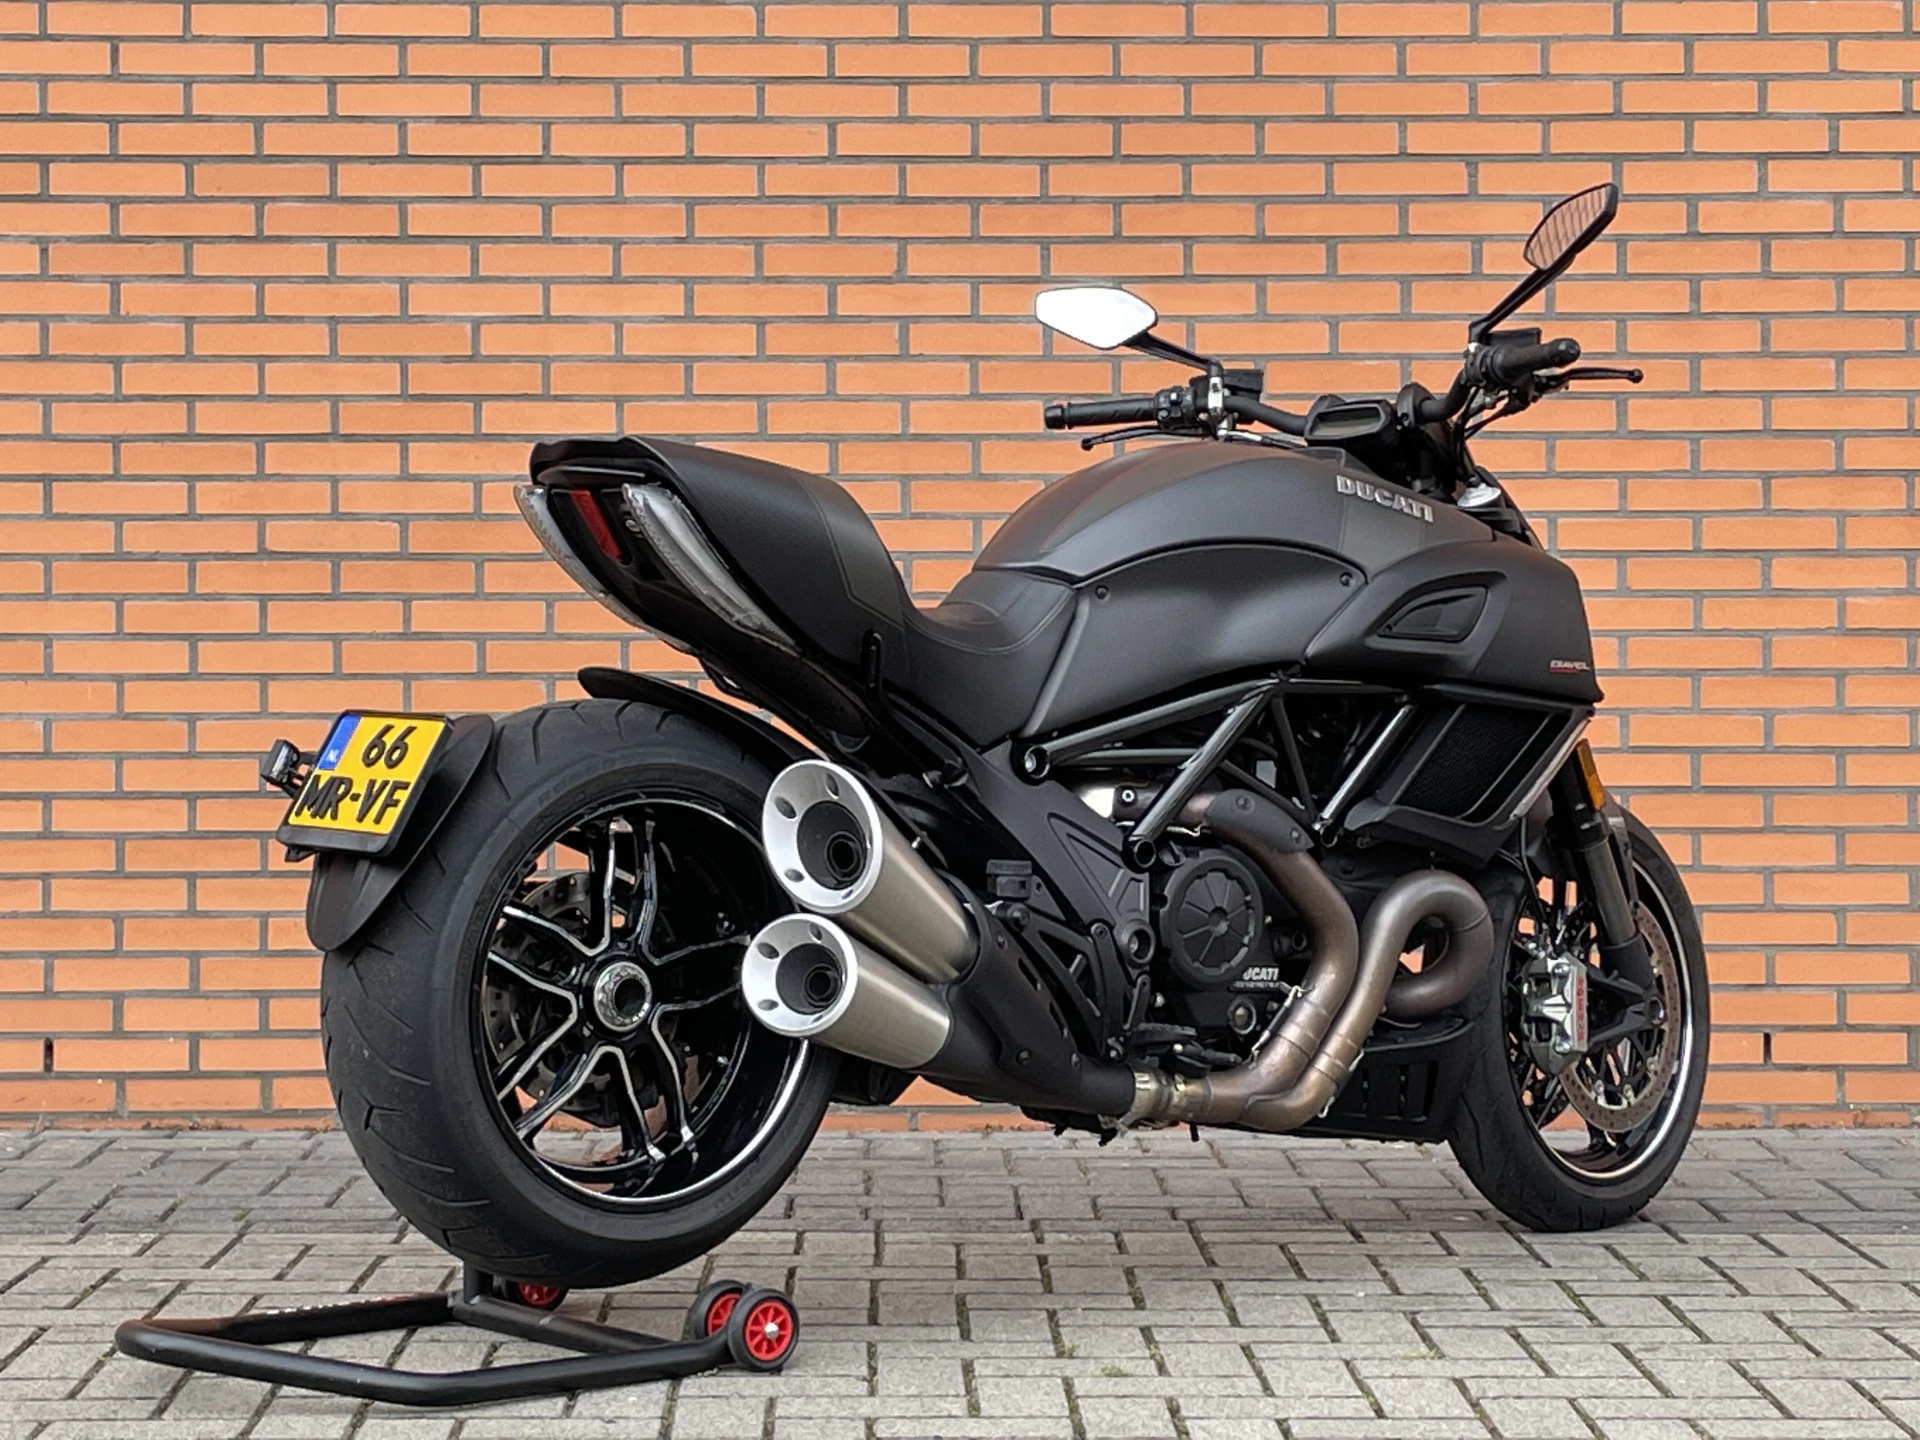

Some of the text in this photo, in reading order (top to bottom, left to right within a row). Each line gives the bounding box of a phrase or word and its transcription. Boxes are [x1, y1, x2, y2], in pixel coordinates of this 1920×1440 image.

[1336, 474, 1434, 523] DUCATI
[361, 724, 418, 769] 66
[294, 774, 412, 825] MR-VF
[1242, 967, 1280, 981] UCATI
